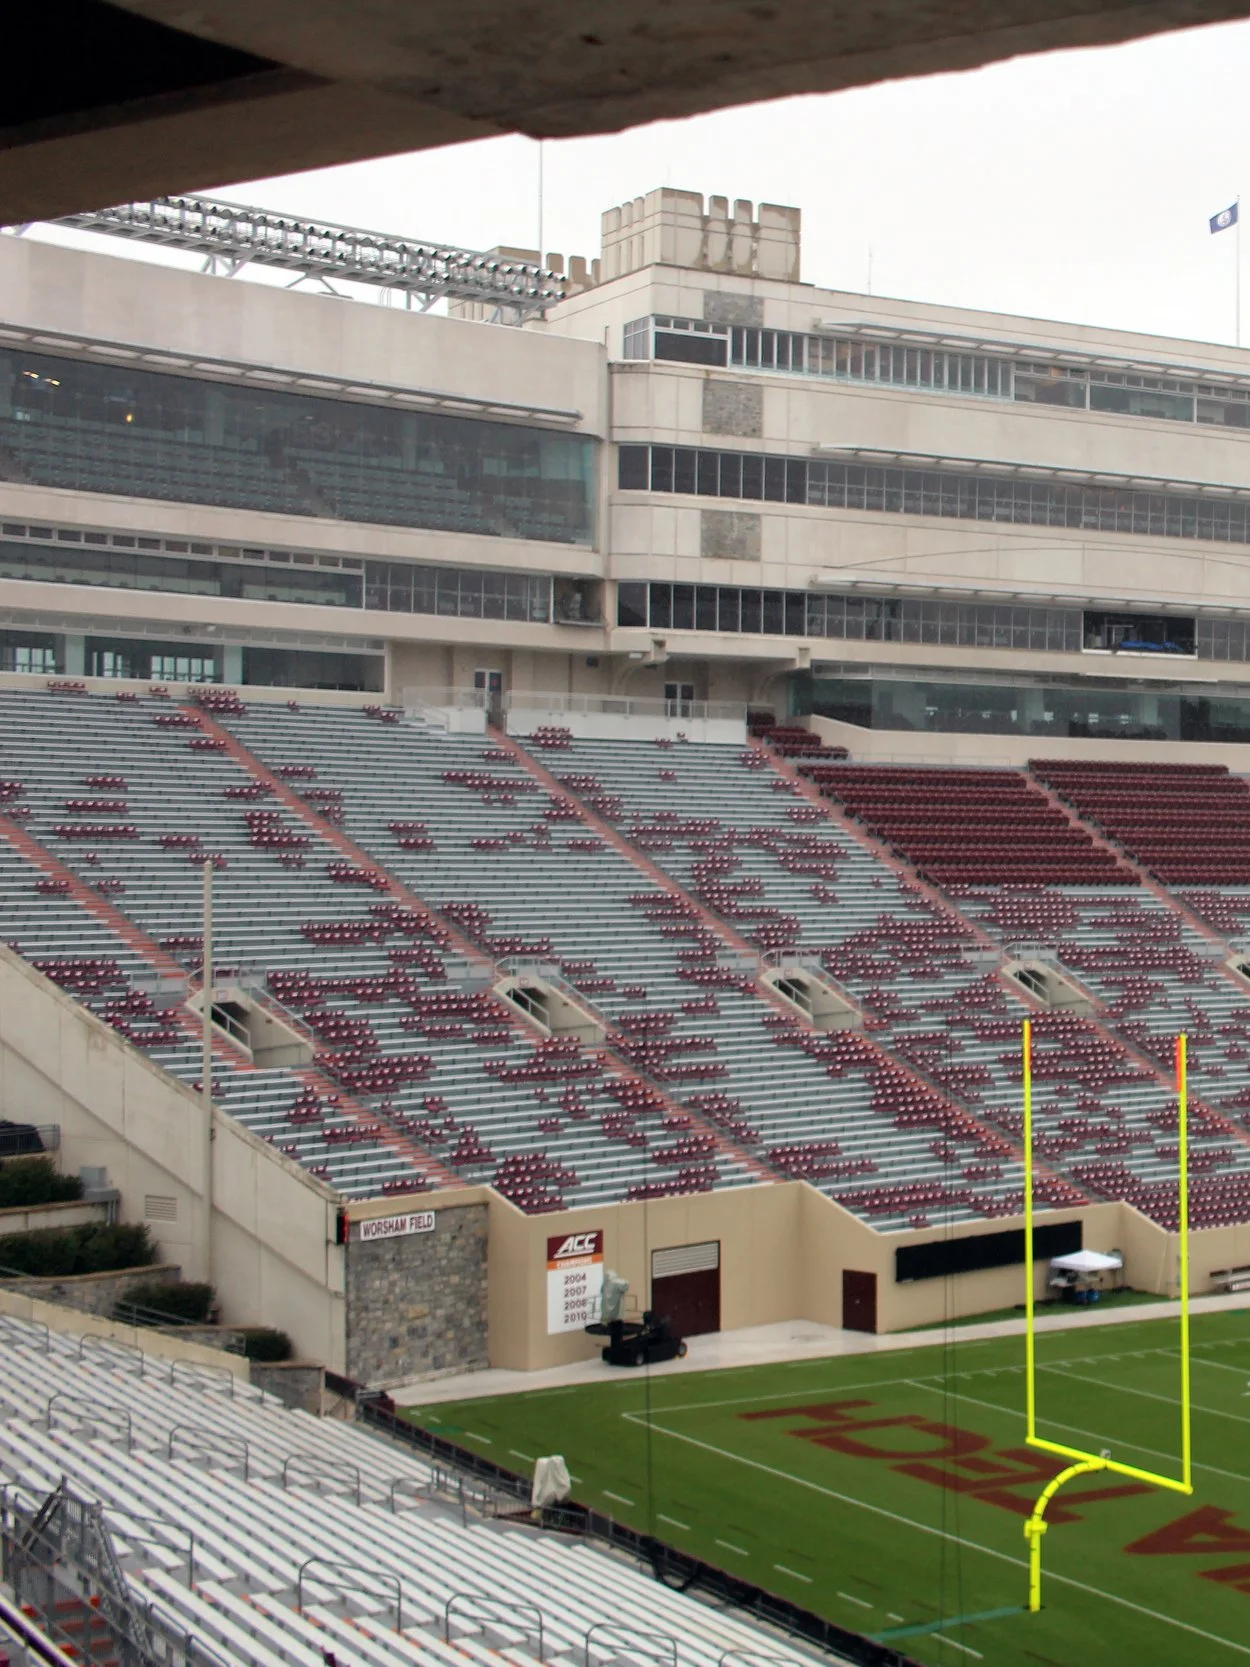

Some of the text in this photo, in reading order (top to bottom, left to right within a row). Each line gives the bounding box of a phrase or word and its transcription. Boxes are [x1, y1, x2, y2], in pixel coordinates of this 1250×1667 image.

[363, 1214, 433, 1237] WORSHAM FIELD
[554, 1232, 598, 1259] ACC
[564, 1273, 587, 1285] 2004
[564, 1286, 587, 1298] 2007
[564, 1312, 587, 1324] 2010
[738, 1399, 1156, 1525] TECH
